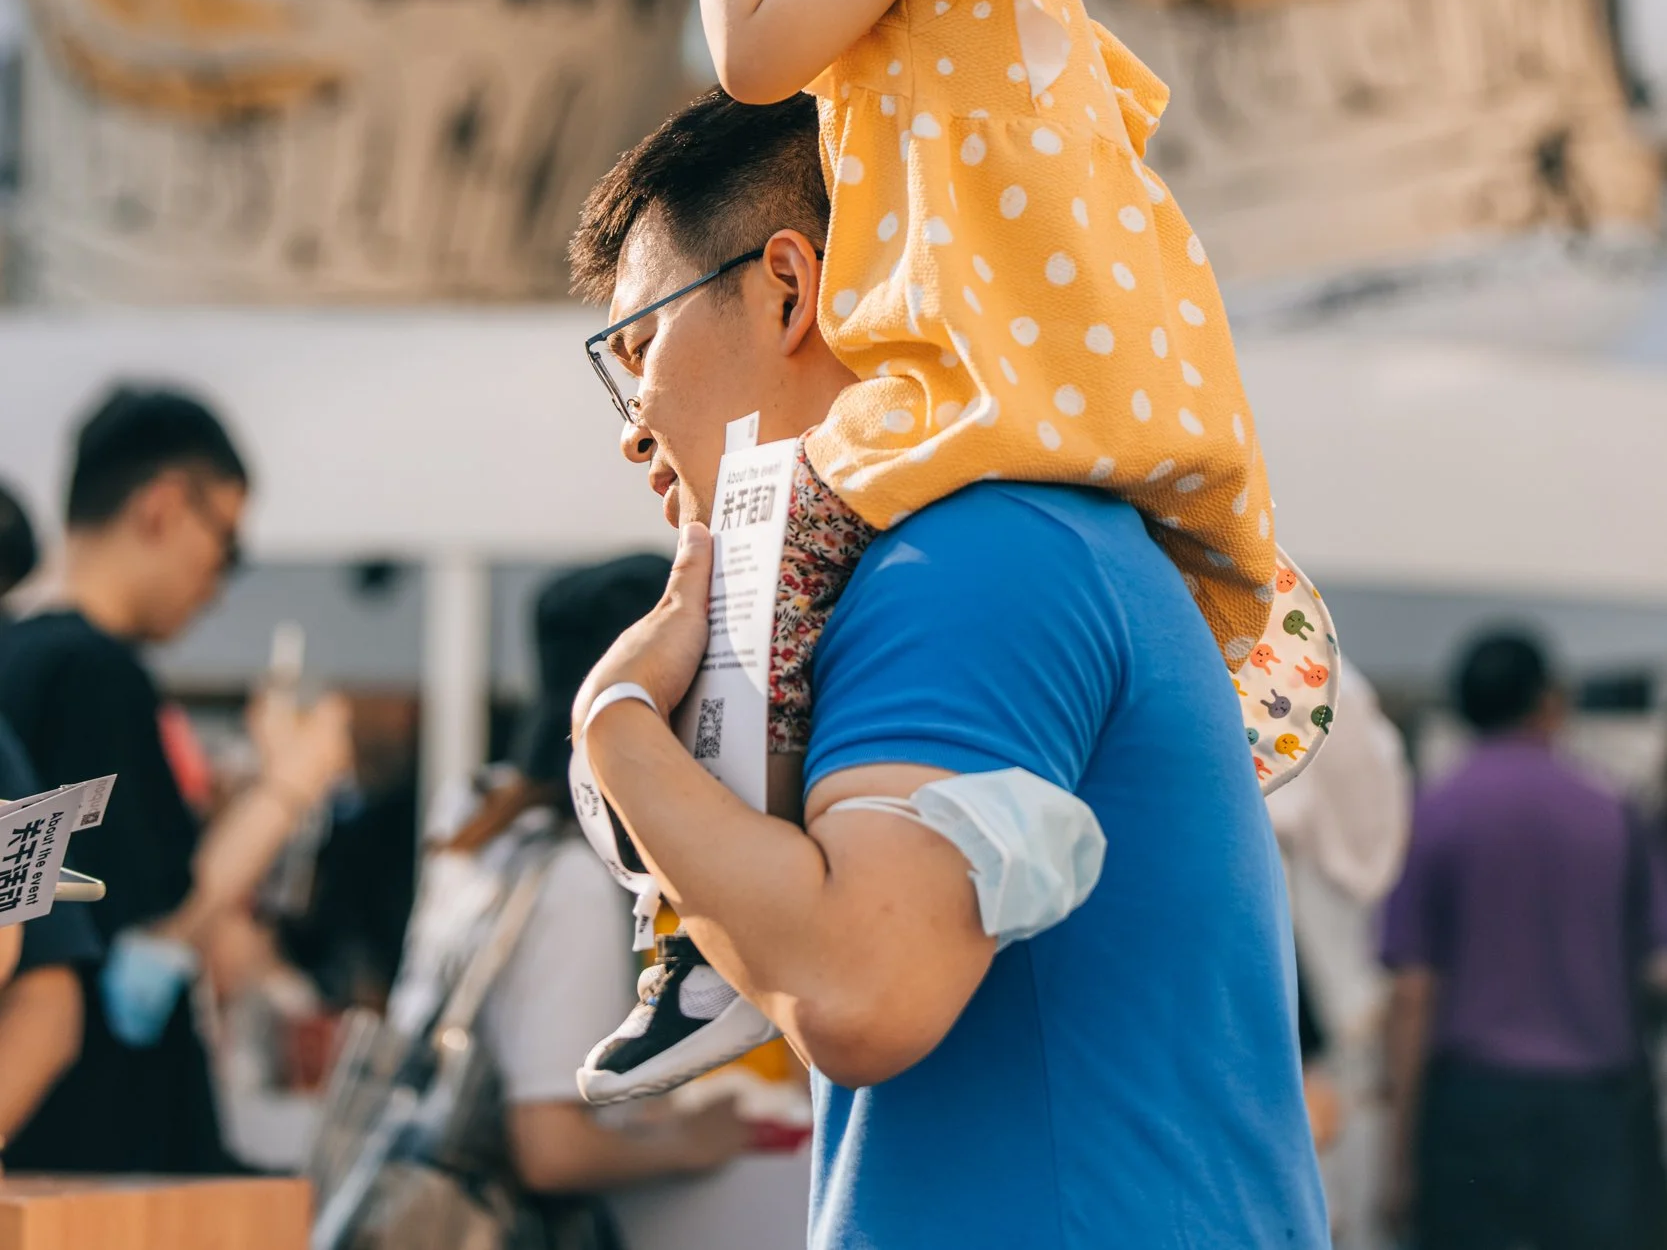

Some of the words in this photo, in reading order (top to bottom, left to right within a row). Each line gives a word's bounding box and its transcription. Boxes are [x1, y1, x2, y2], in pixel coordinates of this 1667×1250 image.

[42, 811, 64, 846] About
[36, 848, 52, 868] the
[25, 871, 43, 906] event
